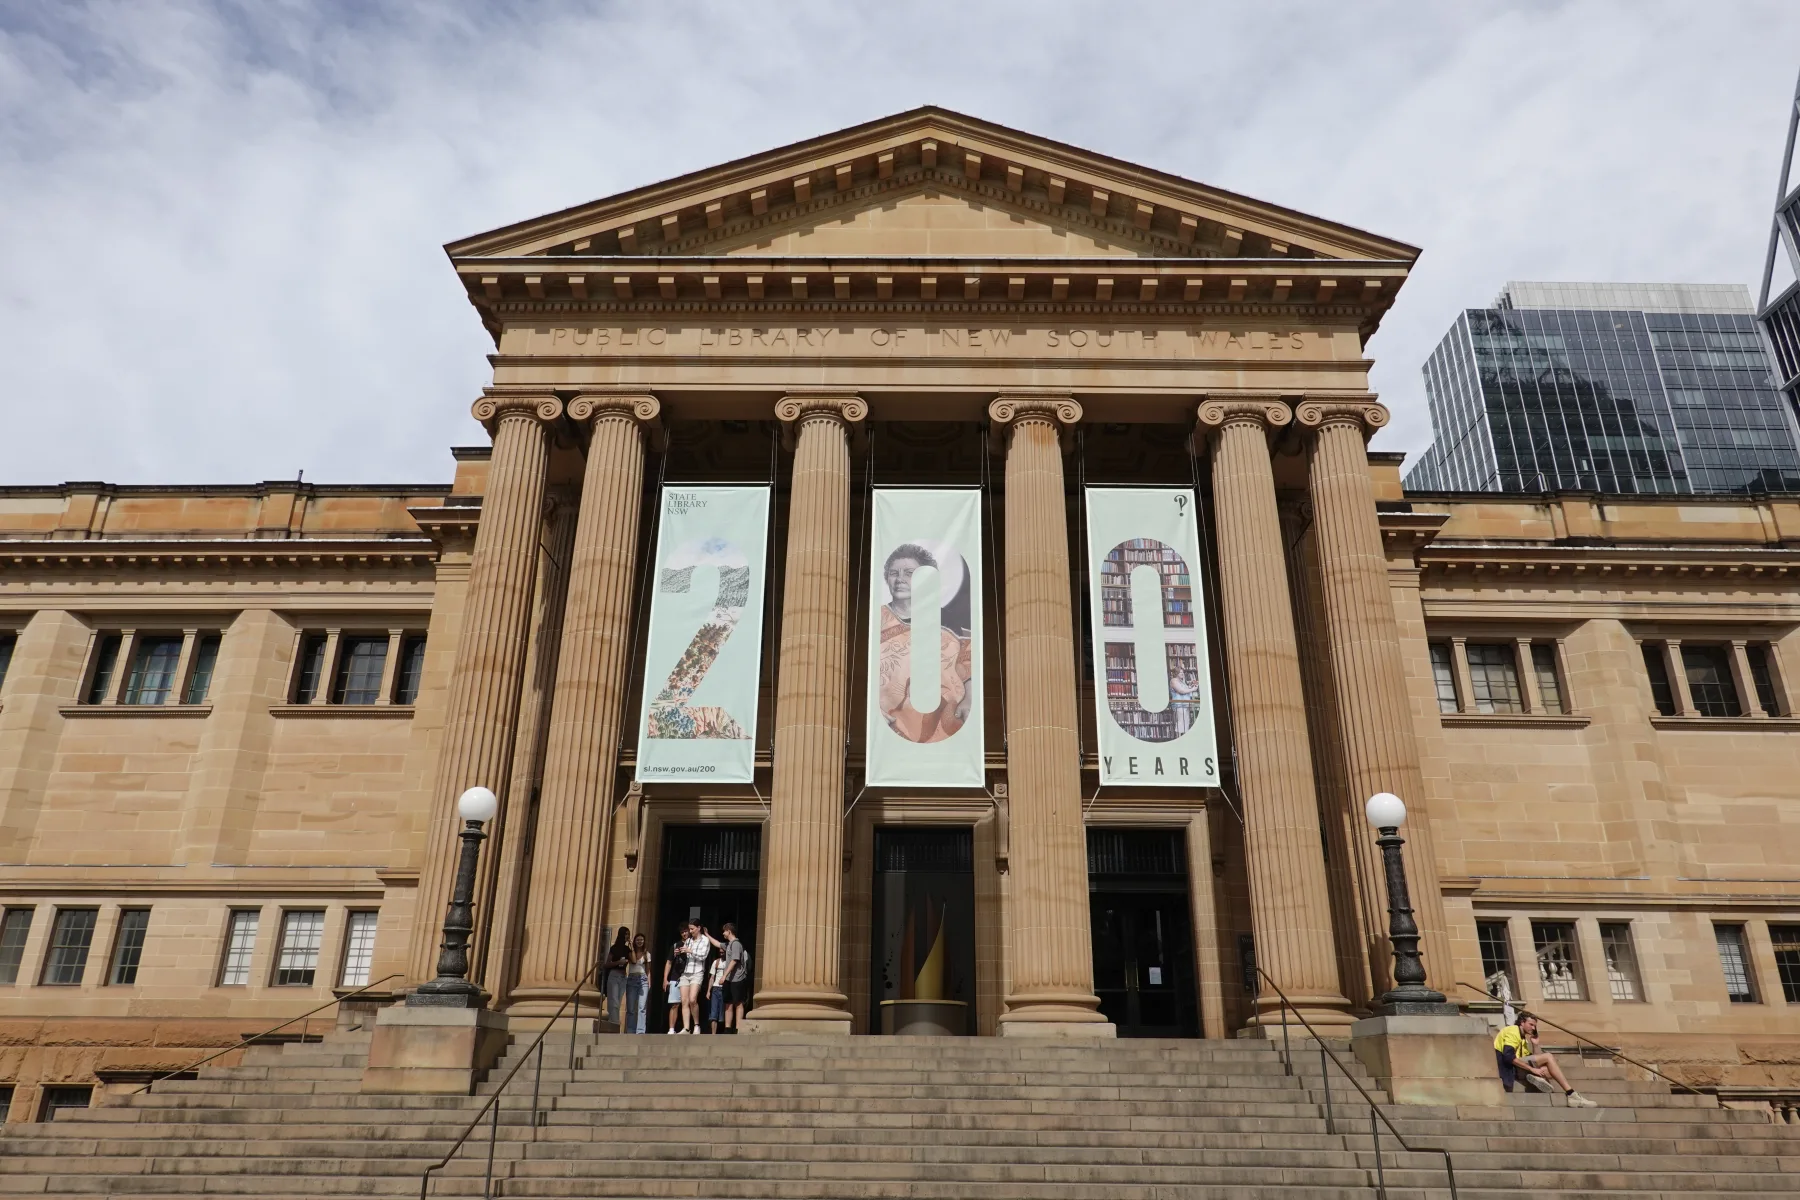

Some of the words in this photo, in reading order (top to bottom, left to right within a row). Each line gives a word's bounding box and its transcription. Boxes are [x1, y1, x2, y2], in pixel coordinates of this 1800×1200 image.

[552, 327, 666, 346] PUBLIC
[700, 327, 834, 347] LIBRARY
[869, 327, 908, 347] OF
[941, 328, 1013, 347] NEW
[1046, 329, 1159, 349] SOUTH
[1195, 330, 1305, 350] WALES
[668, 493, 697, 501] STATE
[668, 500, 708, 508] LIBRARY
[667, 507, 689, 515] NSW
[643, 765, 716, 774] sl.nsw.gov.au/200
[1103, 756, 1215, 776] YEARS
